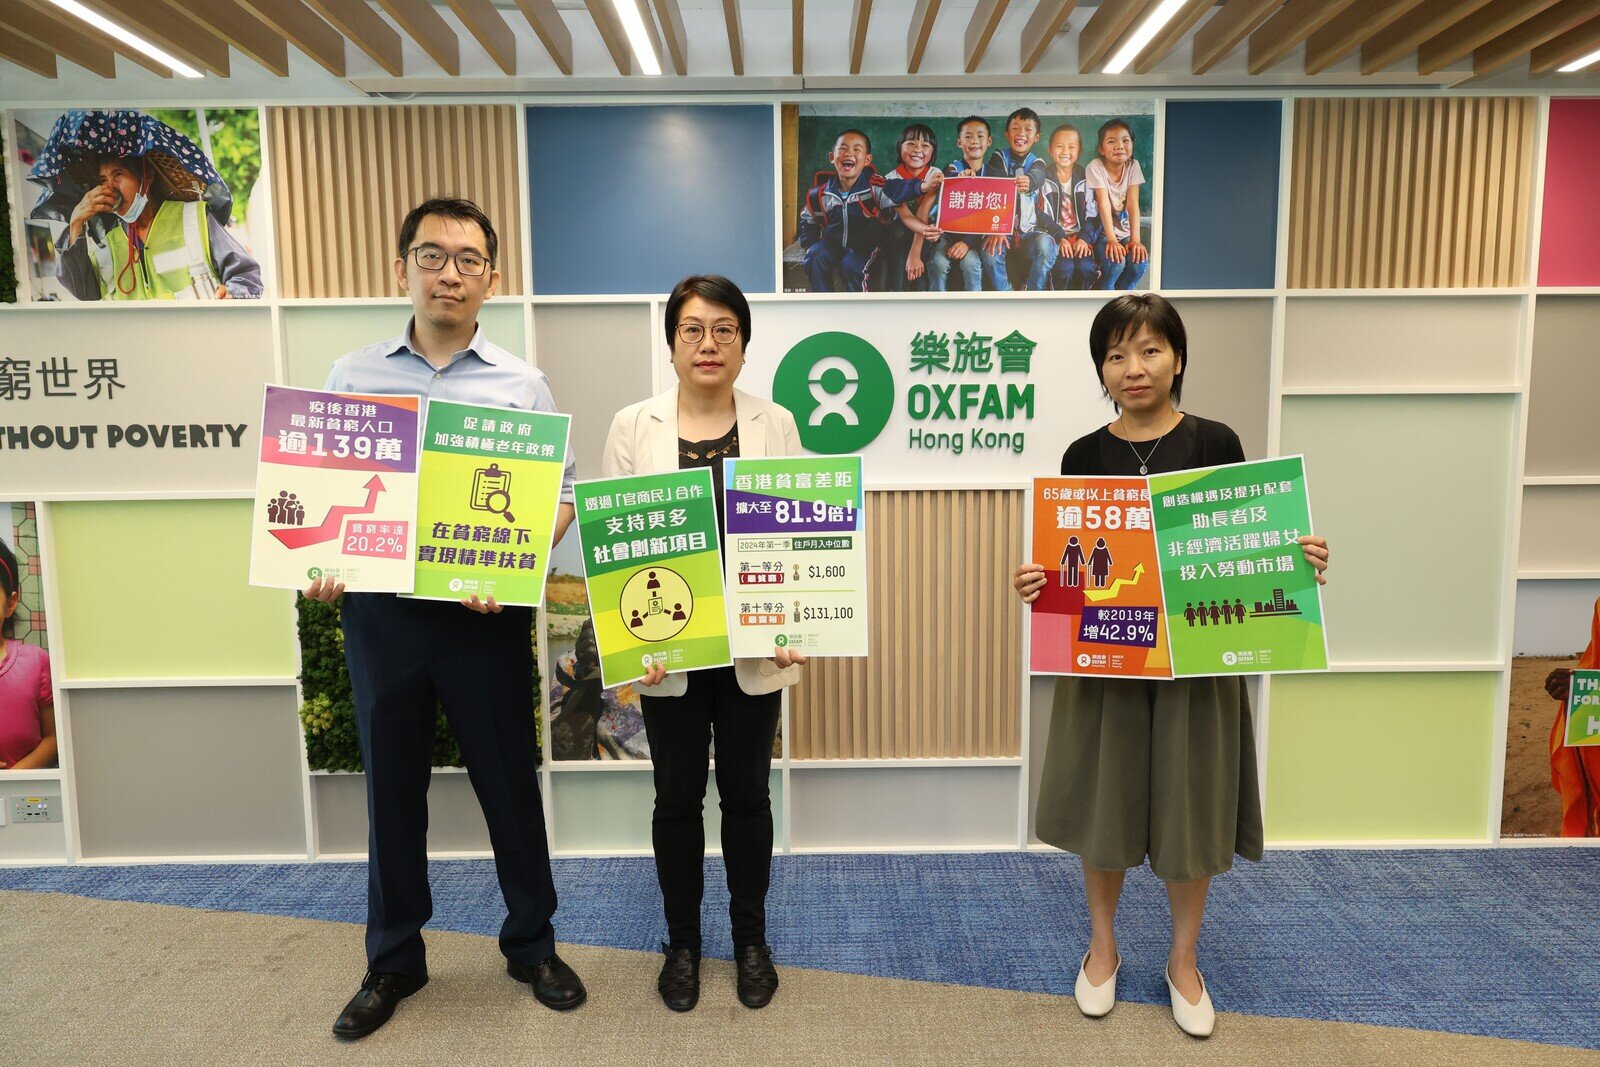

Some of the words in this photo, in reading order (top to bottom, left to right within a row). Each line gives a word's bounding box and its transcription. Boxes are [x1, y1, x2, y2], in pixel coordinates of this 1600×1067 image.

[948, 190, 1008, 210] 謝謝您!
[909, 329, 1037, 375] 樂施會
[0, 357, 126, 400] 窮世界
[308, 400, 378, 418] 疫後香港
[908, 384, 1035, 420] OXFAM
[289, 413, 393, 434] 最新貧窮人口
[463, 416, 533, 436] 促請政府
[107, 423, 248, 449] POVERTY
[277, 429, 403, 462] 逾139萬
[433, 431, 557, 458] 加強積極老年政策
[909, 428, 963, 454] Hong
[972, 428, 1025, 454] Kong
[734, 471, 852, 490] 香港貧富差距
[1162, 480, 1293, 507] 創造機遇及提升配套
[605, 509, 688, 536] 支持更多
[1056, 505, 1152, 531] 逾58萬
[1192, 506, 1269, 529] 助長者及
[346, 535, 404, 554] 20.2%
[432, 522, 533, 545] 在貧窮線下
[1168, 528, 1300, 557] 非經濟活躍婦女
[418, 544, 538, 571] 實現精準扶貧
[592, 532, 708, 565] 社會創新項目
[739, 561, 784, 572] 第一等分
[808, 564, 846, 579] $1,600
[1179, 555, 1295, 582] 投入勞動市場
[740, 602, 785, 614] 第十等分
[803, 606, 854, 621] $131,100
[1097, 610, 1155, 623] 較2019年
[1083, 624, 1155, 642] 增42.9%
[1577, 678, 1600, 691] TH
[1573, 695, 1600, 706] FOR
